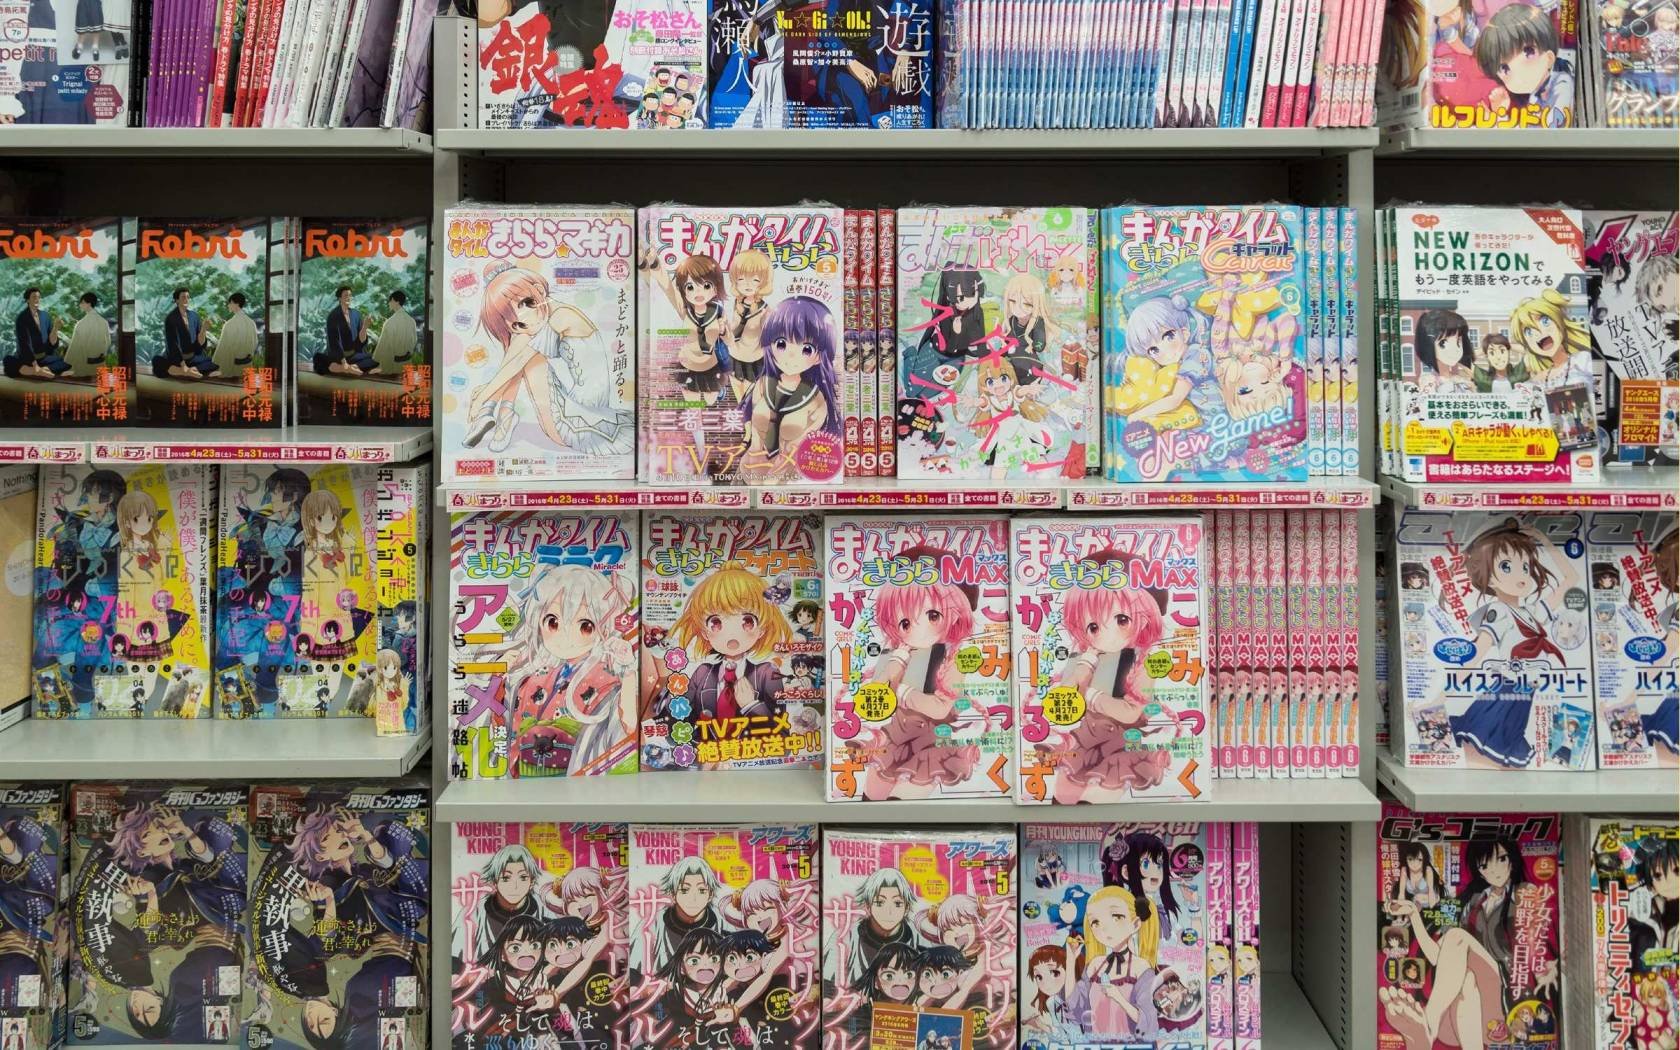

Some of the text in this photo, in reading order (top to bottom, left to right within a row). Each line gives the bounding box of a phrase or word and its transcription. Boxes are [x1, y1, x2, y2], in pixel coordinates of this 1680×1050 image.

[613, 9, 702, 29] おそ松さん
[876, 3, 931, 96] 遊戯
[450, 220, 491, 241] まんが
[1414, 231, 1470, 249] NEW
[451, 239, 490, 257] タイム
[658, 214, 841, 274] まんがタイム
[754, 241, 841, 271] きらら
[1200, 239, 1294, 274] Carat
[1232, 242, 1294, 257] キャラット
[1127, 243, 1202, 272] きらら
[1415, 253, 1530, 271] HORIZON
[1415, 273, 1553, 287] もう一度英語をやってみる
[657, 410, 744, 431] 三者三葉
[1206, 398, 1294, 462] Game!
[657, 444, 797, 476] TVアニメ
[464, 515, 632, 560] まんがタイム
[651, 516, 815, 562] まんがタイム
[466, 551, 536, 580] きらら
[593, 563, 626, 571] Miracle!
[862, 556, 940, 587] きらら
[940, 555, 1010, 586] MAX
[1050, 560, 1129, 590] きらら
[1130, 558, 1200, 590] MAX
[97, 593, 137, 625] 7th
[1443, 671, 1587, 693] ハイスクール・フリート
[697, 712, 791, 740] TVアニメ
[697, 731, 823, 763] 絶賛放送中!!
[457, 822, 502, 838] YOUNG
[634, 831, 680, 848] YOUNG
[750, 824, 813, 845] アワーズ
[467, 838, 502, 854] KING
[645, 848, 681, 865] KING
[829, 839, 877, 857] YOUNG
[945, 839, 1015, 859] アワーズ
[797, 854, 812, 880] 5
[840, 858, 876, 876] KING
[996, 870, 1009, 896] 5
[87, 861, 131, 954] 黒執事
[262, 865, 307, 962] 黒執事
[498, 1010, 596, 1033] そして魂は
[679, 1026, 776, 1046] そして魂は
